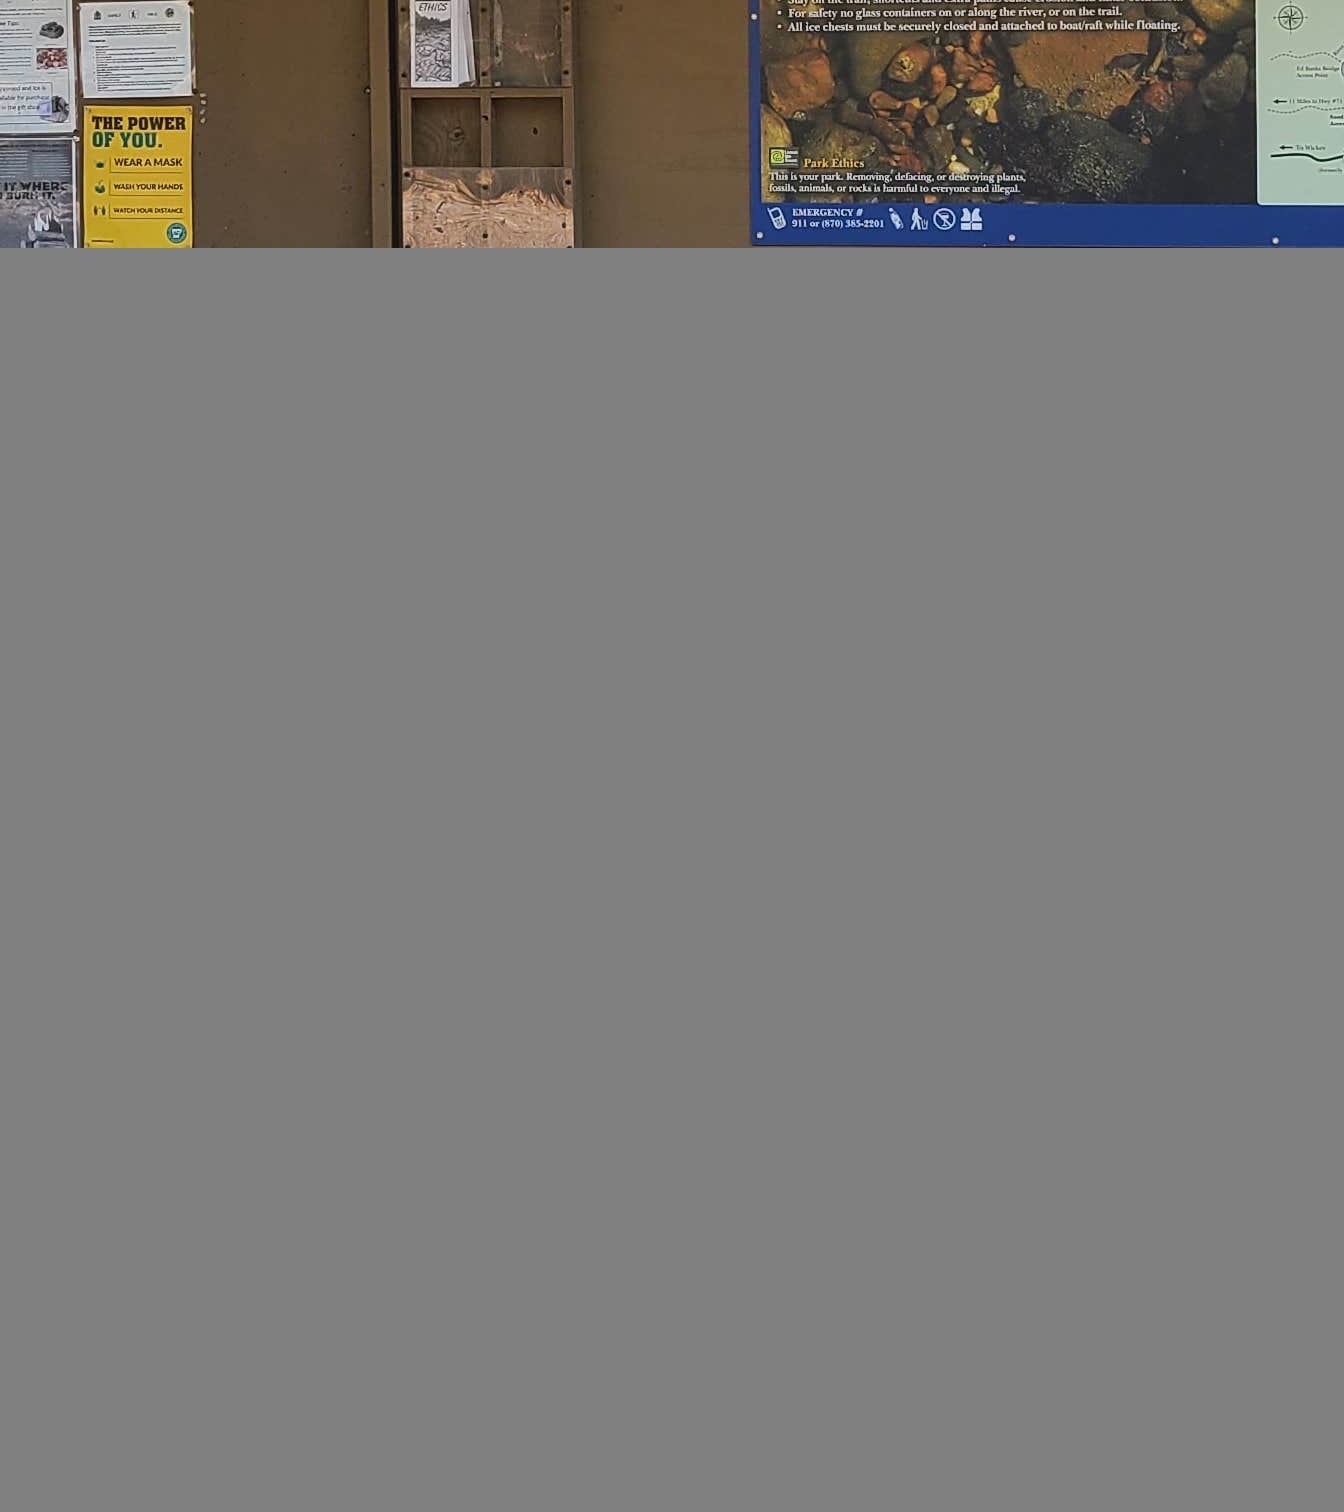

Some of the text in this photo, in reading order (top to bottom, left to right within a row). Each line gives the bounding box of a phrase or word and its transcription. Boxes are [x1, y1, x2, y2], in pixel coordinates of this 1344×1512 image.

[419, 3, 448, 11] ETHICS
[787, 20, 1181, 34] All ice chests must be securely closed and attached to boat/raft while floating.
[92, 116, 186, 130] THE POWER
[92, 132, 162, 148] OF YOU.
[154, 158, 182, 166] MASK
[803, 158, 865, 168] Park Ethics
[792, 207, 854, 217] EMERGENCY
[792, 219, 807, 228] 911
[821, 219, 844, 230] (870)
[845, 219, 884, 228] 385-2201
